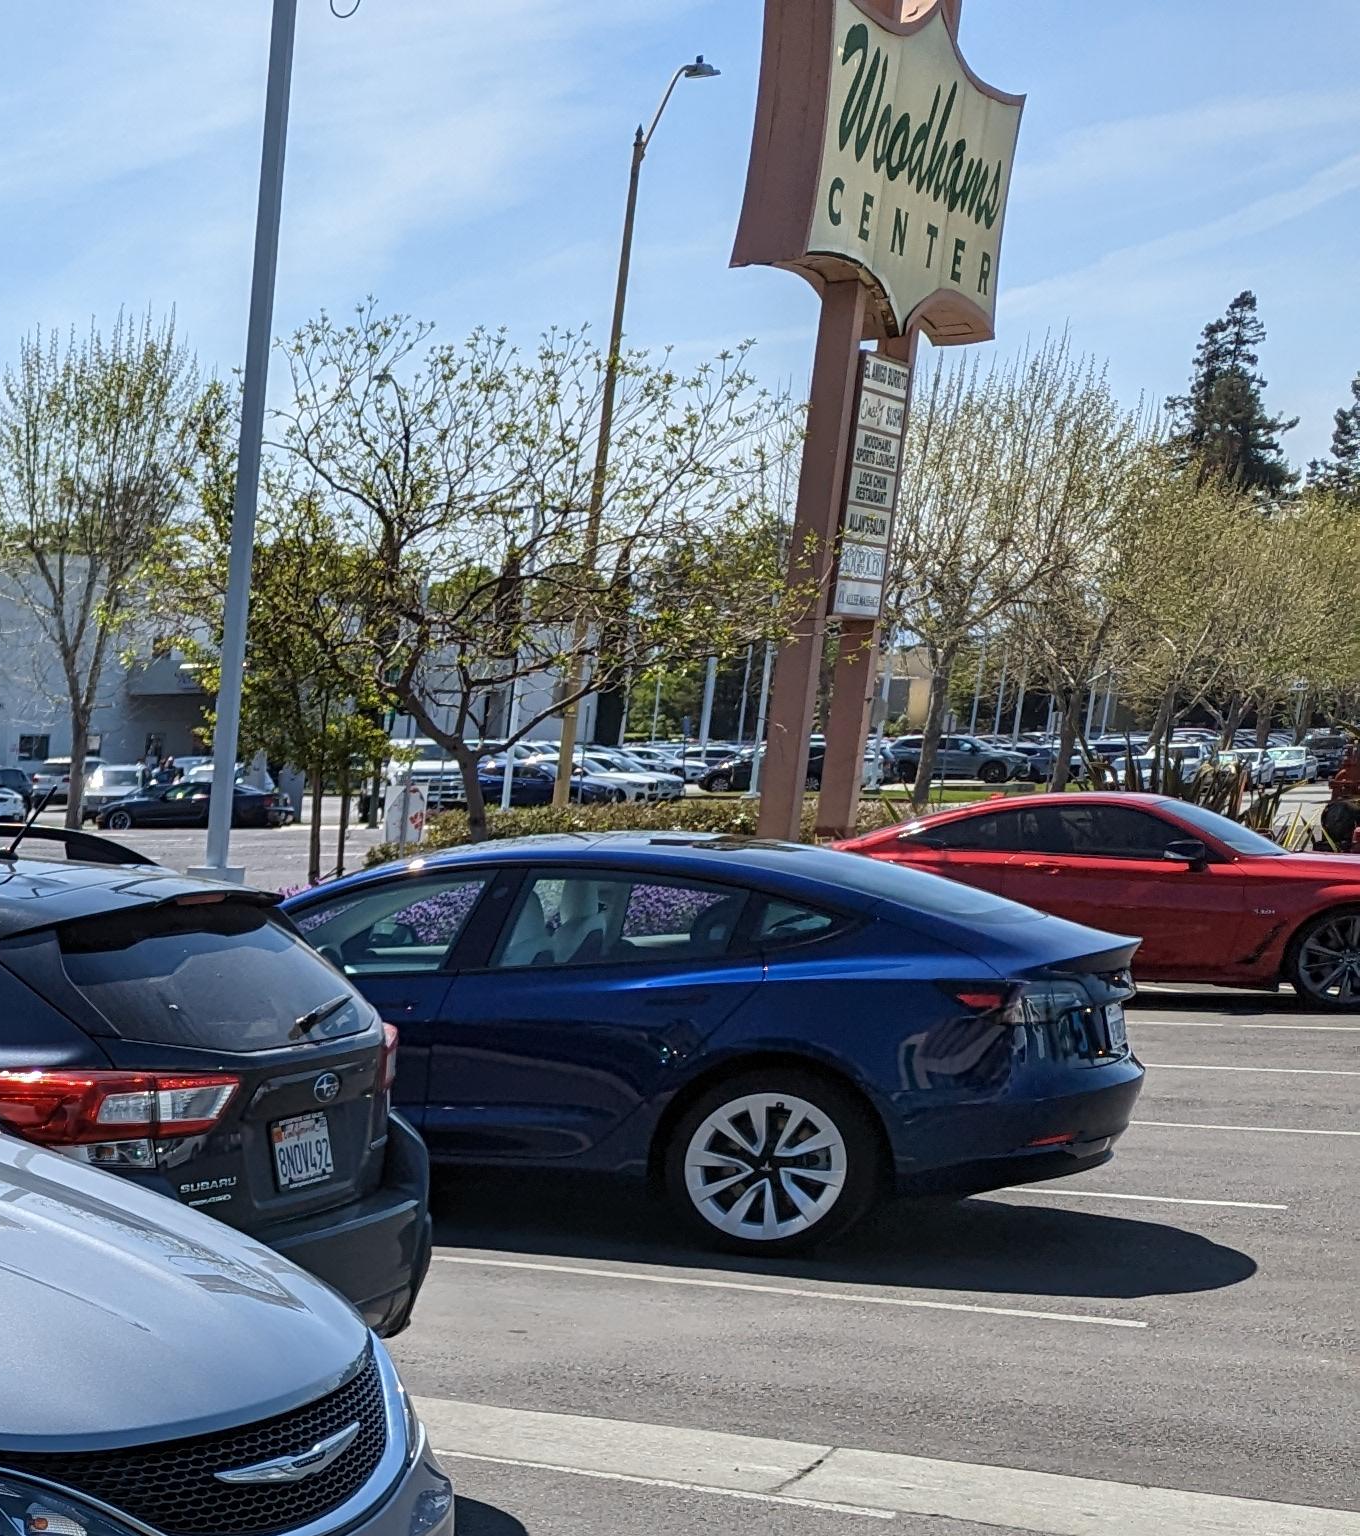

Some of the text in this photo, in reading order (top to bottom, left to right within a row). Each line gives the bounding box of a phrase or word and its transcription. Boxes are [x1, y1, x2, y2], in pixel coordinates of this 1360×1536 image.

[839, 23, 1002, 230] Woodhams
[828, 176, 992, 296] CENTER
[863, 433, 892, 454] WOODHAMS
[855, 448, 896, 470] SPORTS LOUNGE
[855, 485, 887, 505] RESTAURANT
[278, 1137, 331, 1178] 8NOV492
[180, 1176, 237, 1193] SUBARU
